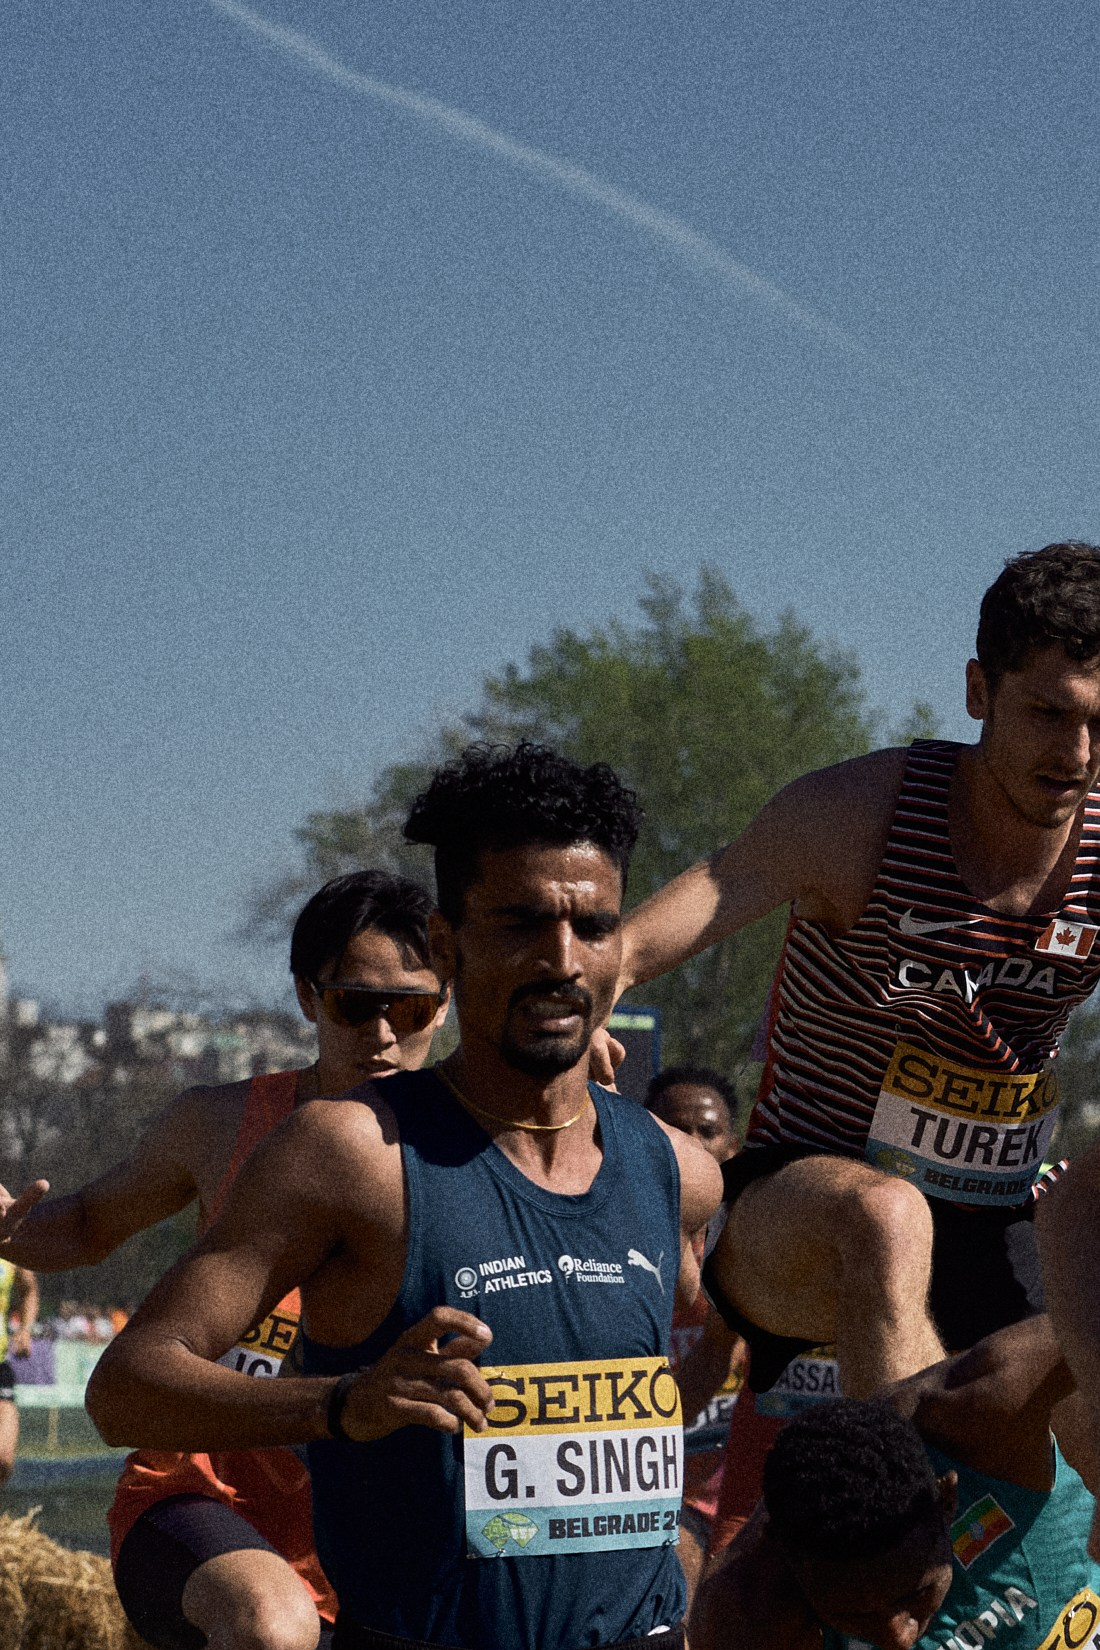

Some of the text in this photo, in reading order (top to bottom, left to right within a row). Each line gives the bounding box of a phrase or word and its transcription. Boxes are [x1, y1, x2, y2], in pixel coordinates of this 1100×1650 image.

[910, 1107, 1046, 1167] TUREK
[923, 1168, 1028, 1195] BELGRADE
[479, 1255, 526, 1277] INDIAN
[573, 1258, 623, 1274] Reliance
[576, 1272, 626, 1284] Foundation
[484, 1269, 553, 1294] ATHLETICS
[485, 1365, 678, 1429] SEIKO
[485, 1434, 679, 1501] G. SINGH
[549, 1511, 660, 1540] BELGRADE
